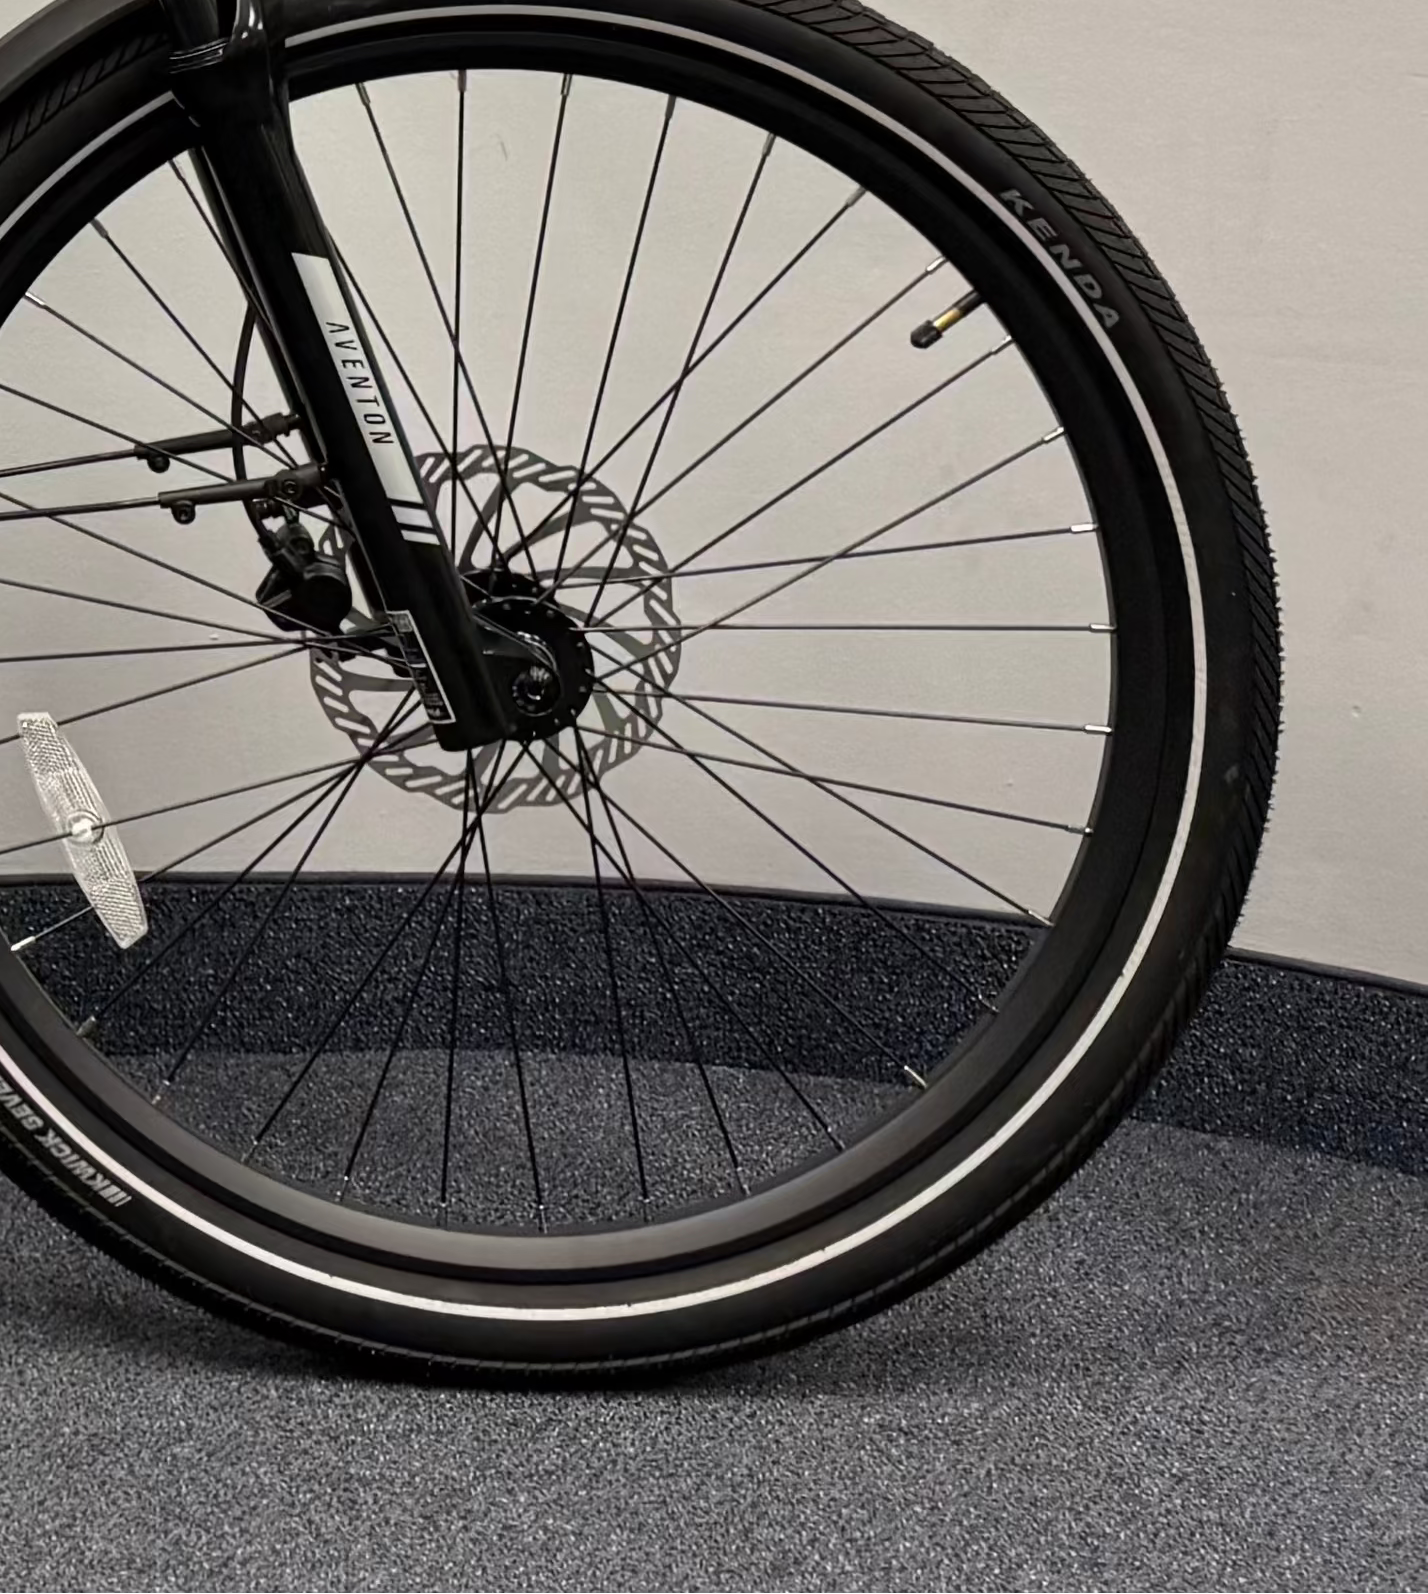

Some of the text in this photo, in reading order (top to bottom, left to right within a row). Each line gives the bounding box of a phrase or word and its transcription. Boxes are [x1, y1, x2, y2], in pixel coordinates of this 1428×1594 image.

[998, 188, 1120, 329] KENDA
[325, 321, 395, 444] AVENTON
[34, 1127, 111, 1192] KWICK
